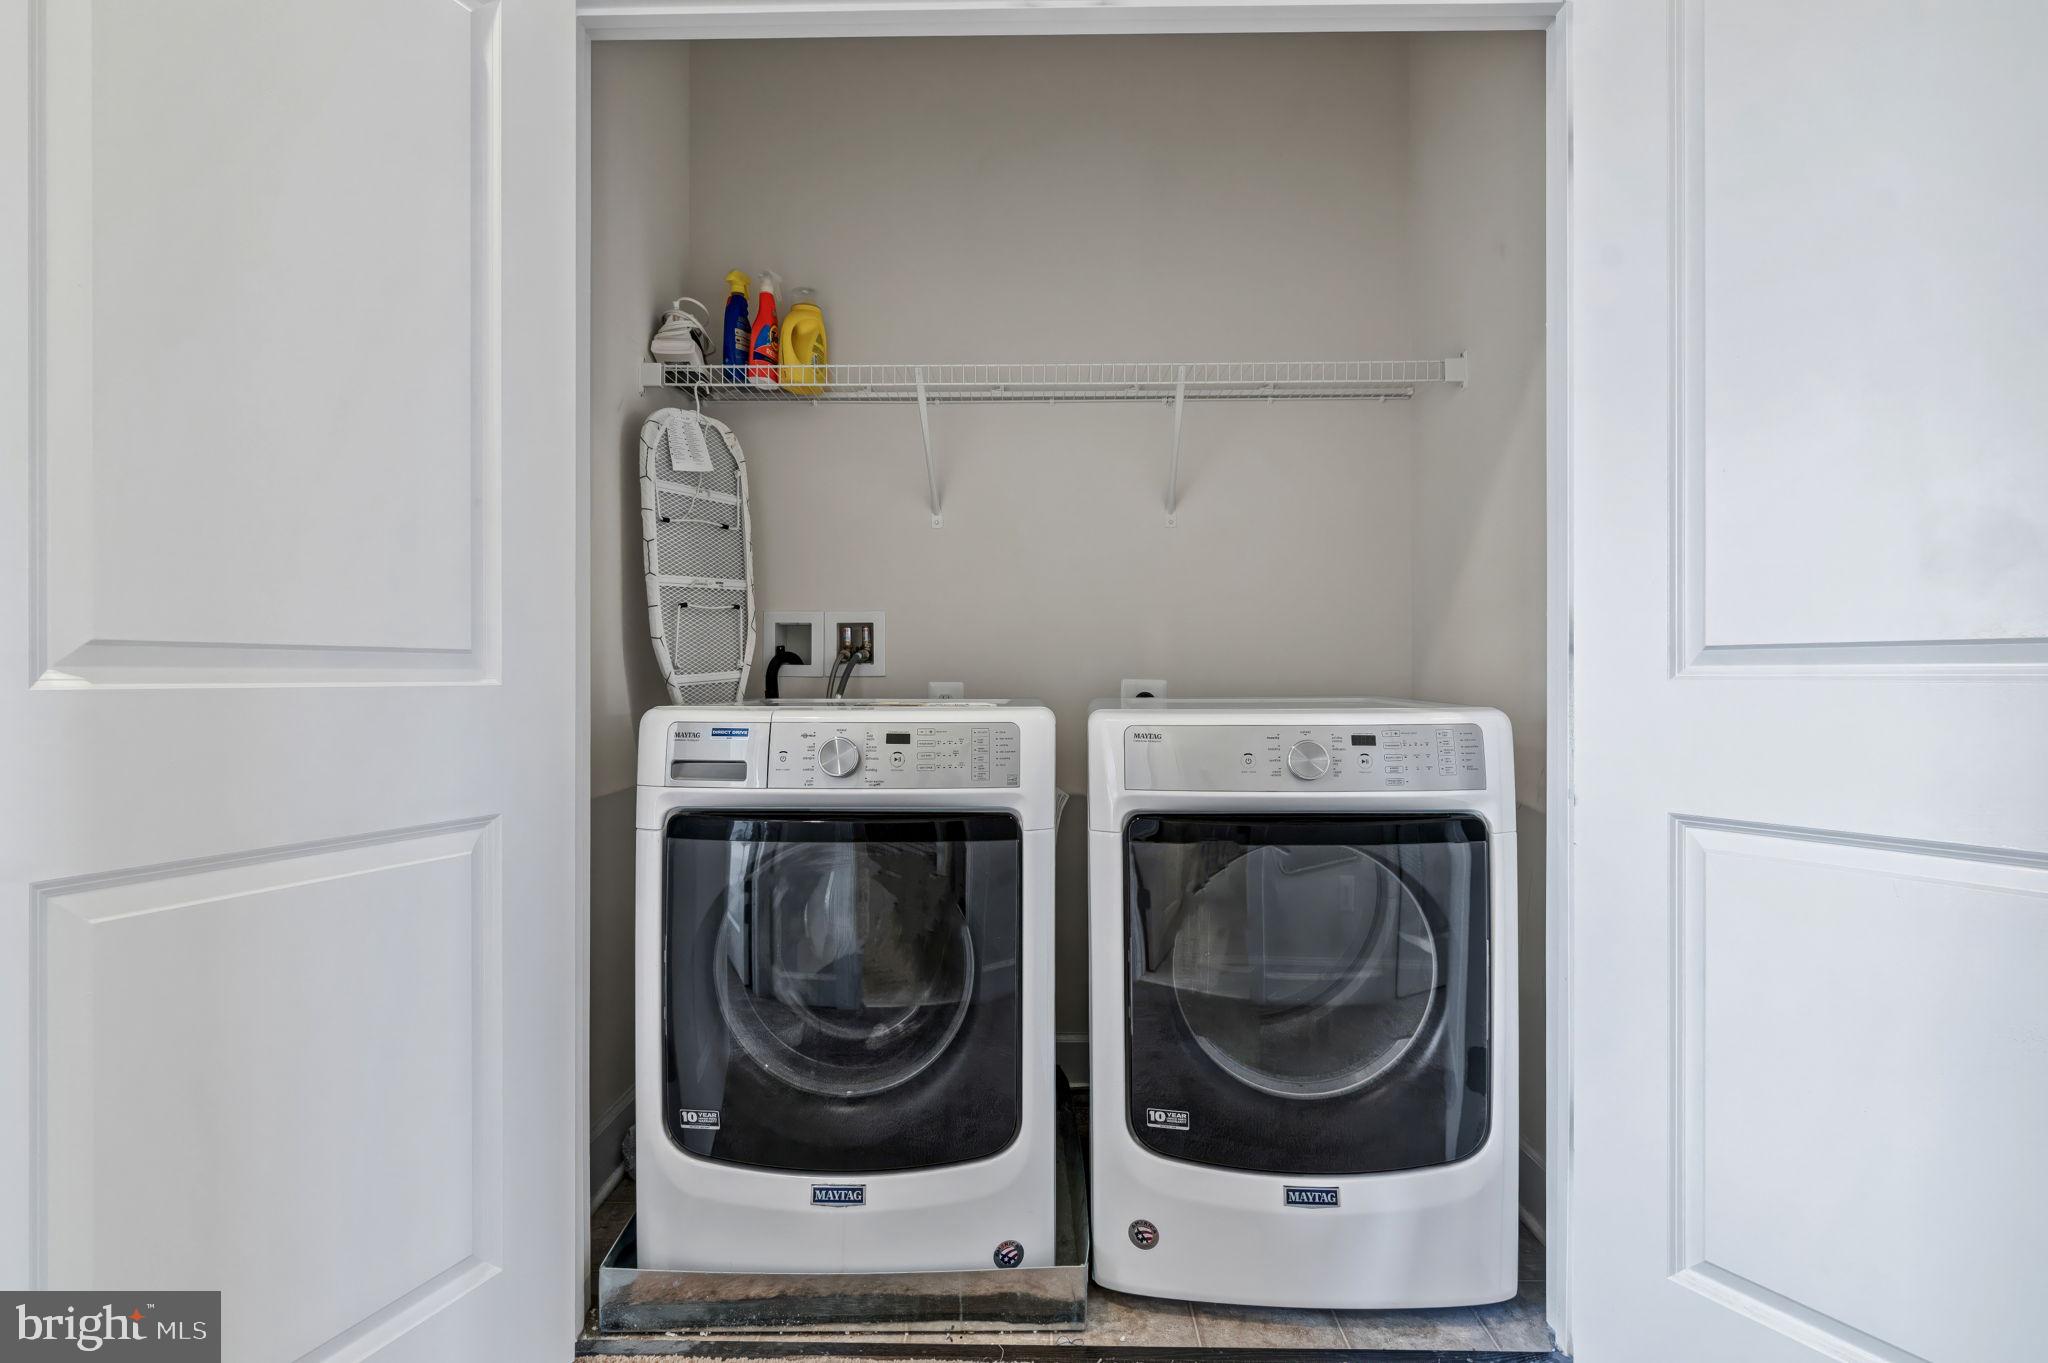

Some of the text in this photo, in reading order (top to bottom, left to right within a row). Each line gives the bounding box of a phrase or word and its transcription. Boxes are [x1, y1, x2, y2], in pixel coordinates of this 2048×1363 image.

[674, 731, 701, 739] MAYTAG
[1133, 732, 1162, 740] MAYTAG
[682, 1111, 697, 1123] 10
[1149, 1110, 1166, 1122] 10
[815, 1190, 862, 1201] MAYTAG
[1288, 1191, 1336, 1203] MAYTAG
